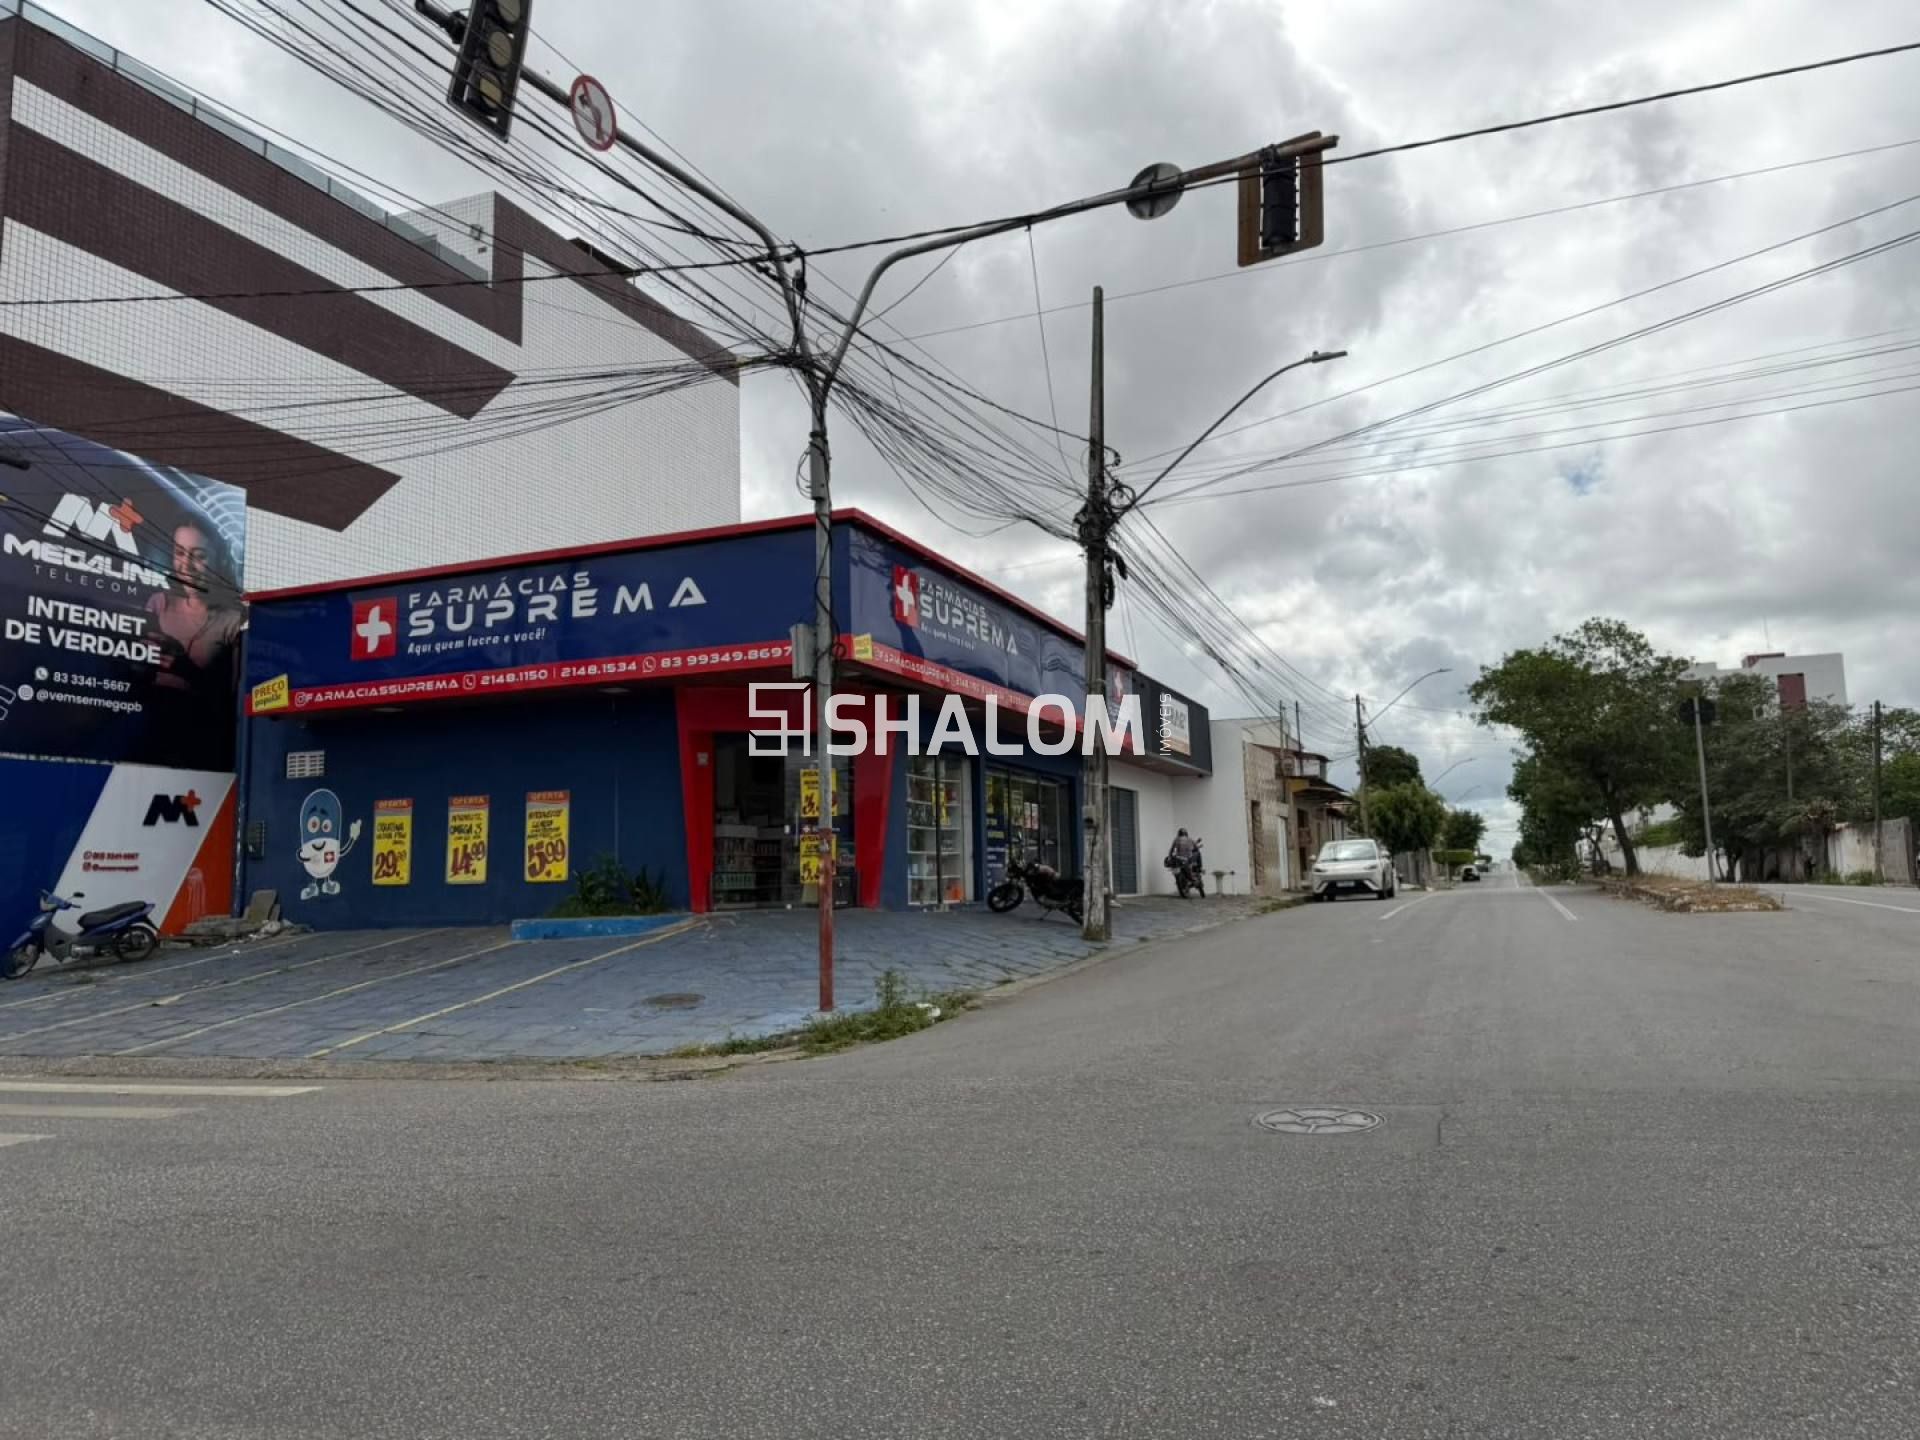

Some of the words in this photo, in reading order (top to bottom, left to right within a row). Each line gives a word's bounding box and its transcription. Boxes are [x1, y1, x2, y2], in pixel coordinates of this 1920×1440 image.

[34, 564, 137, 595] TELECOM
[409, 570, 589, 608] FARMÁCIAS
[28, 596, 146, 636] INTERNET
[408, 576, 707, 636] SUPREMA
[920, 593, 1018, 655] SUPREMA
[6, 619, 41, 643] DE
[48, 626, 161, 664] VERDADE
[408, 642, 431, 656] Aqui
[434, 639, 464, 653] quem
[467, 635, 500, 648] lucra
[504, 635, 510, 643] e
[514, 627, 546, 642] você!
[53, 671, 68, 683] 83
[71, 674, 131, 693] 3341-5667
[561, 660, 637, 678] 2148.1534
[661, 656, 682, 669] 83
[36, 688, 142, 713] @vemsermegapb
